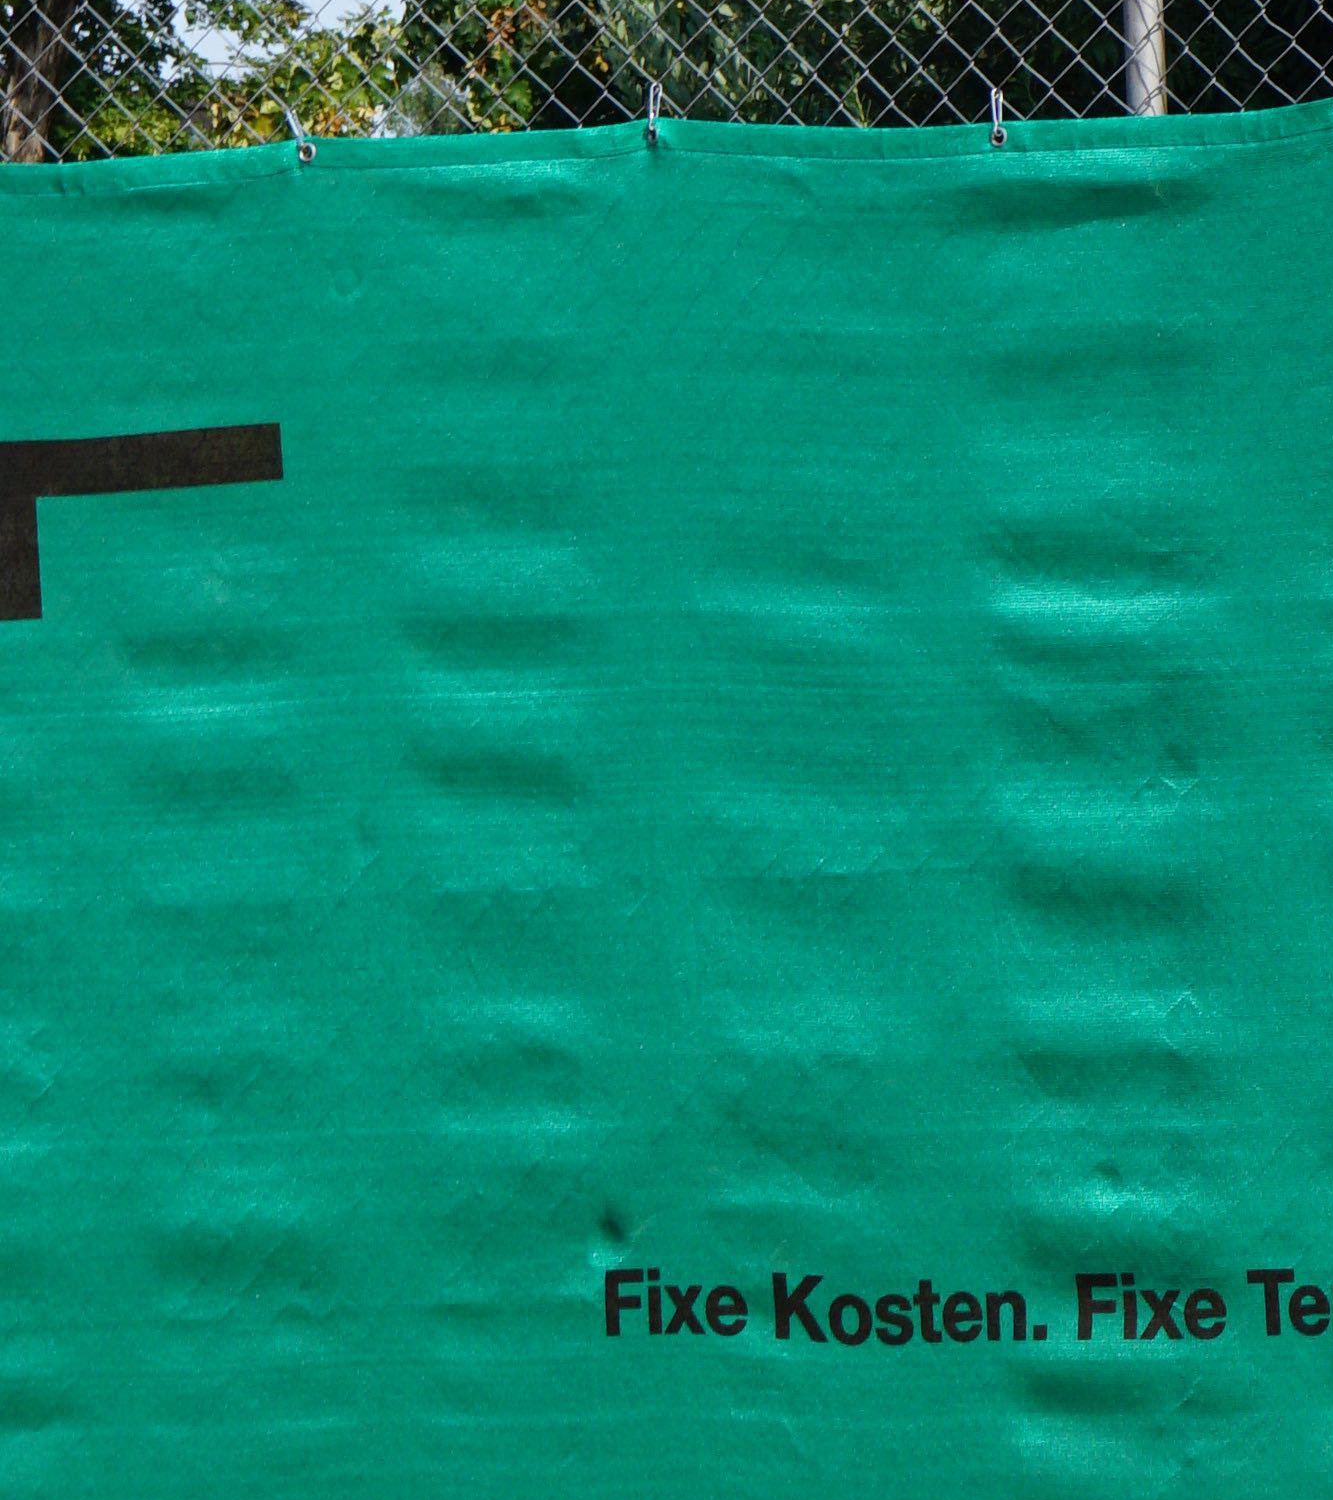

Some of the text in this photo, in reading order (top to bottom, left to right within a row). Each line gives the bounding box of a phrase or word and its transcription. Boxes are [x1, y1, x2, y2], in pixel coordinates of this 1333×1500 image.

[604, 1267, 749, 1337] Fixe
[771, 1272, 1048, 1347] Kosten.
[1072, 1270, 1227, 1341] Fixe
